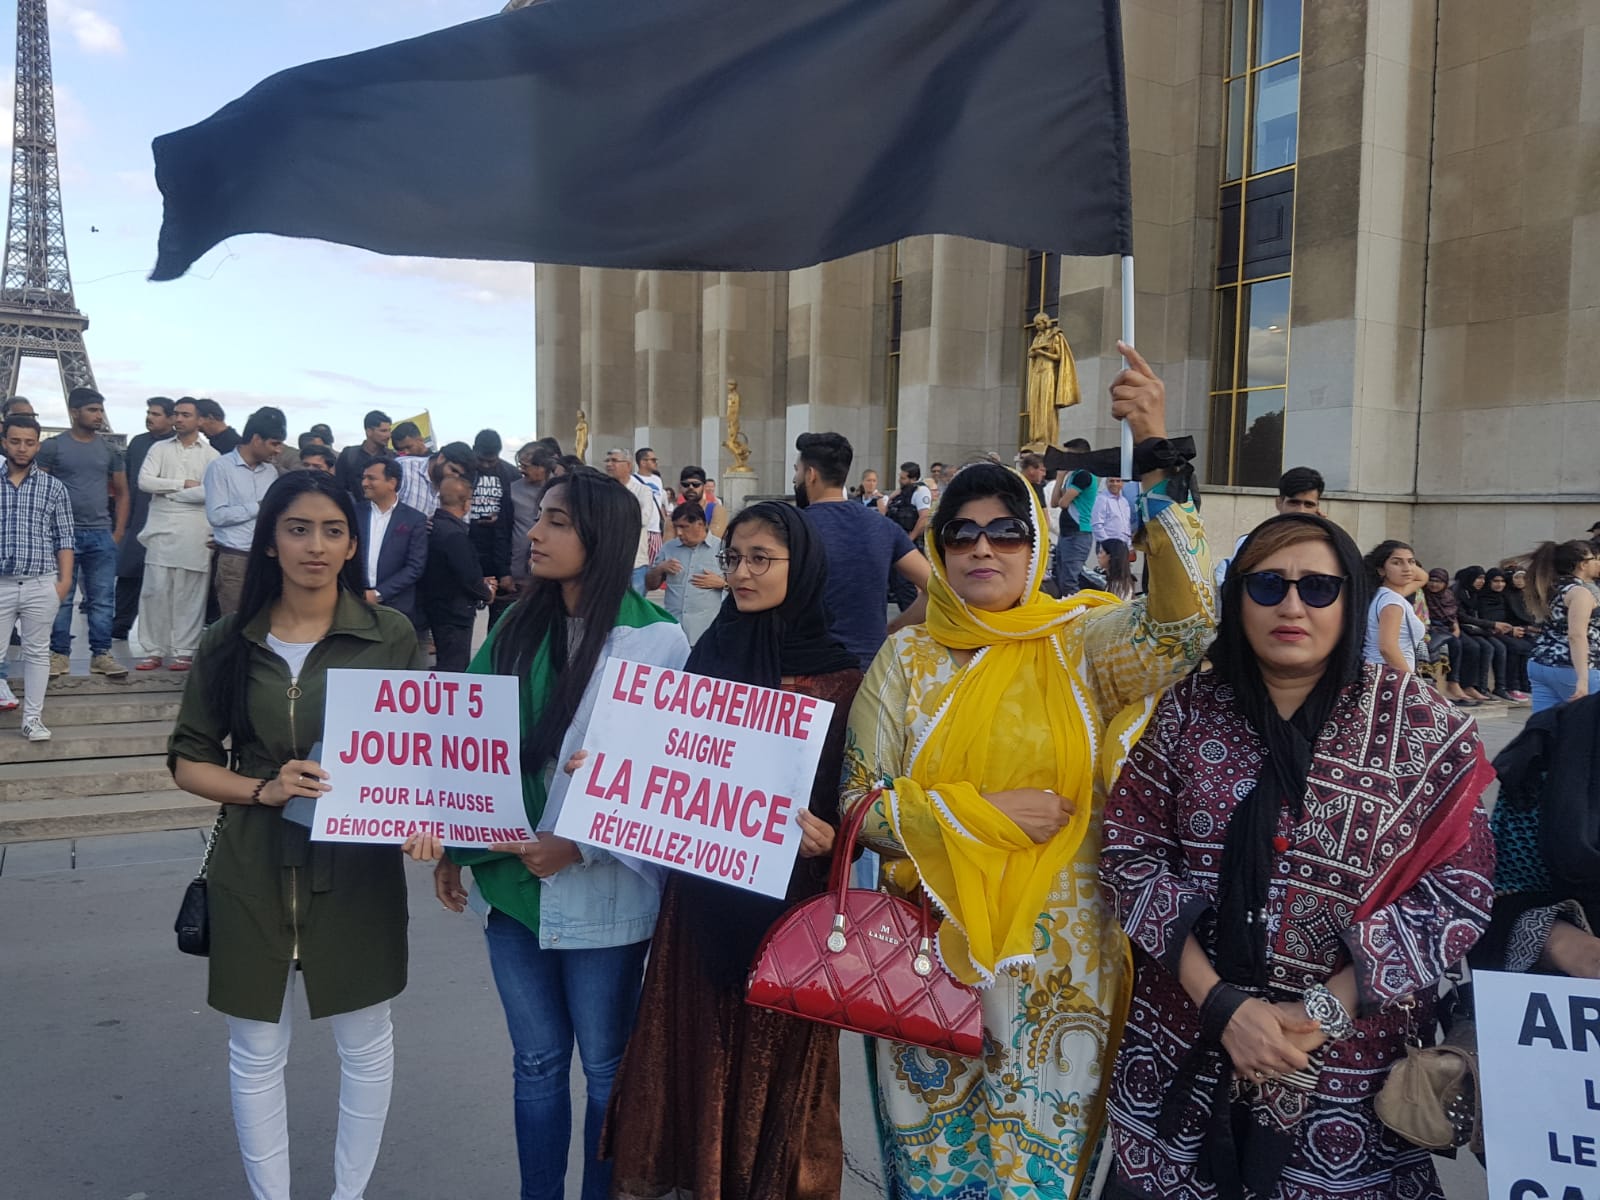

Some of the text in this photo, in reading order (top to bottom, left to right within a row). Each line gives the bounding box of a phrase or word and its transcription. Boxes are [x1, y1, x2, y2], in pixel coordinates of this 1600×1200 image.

[374, 673, 484, 718] AOÛT 5
[612, 661, 817, 740] LE CACHEMIRE
[339, 730, 511, 775] JOUR NOIR
[664, 727, 737, 769] SAIGNE
[359, 786, 495, 814] POUR LA FAUSSE
[585, 752, 792, 845] LA FRANCE
[326, 814, 531, 843] DÉMOCRATIE INDIENNE
[1518, 992, 1600, 1052] AR
[1548, 1131, 1598, 1167] LE
